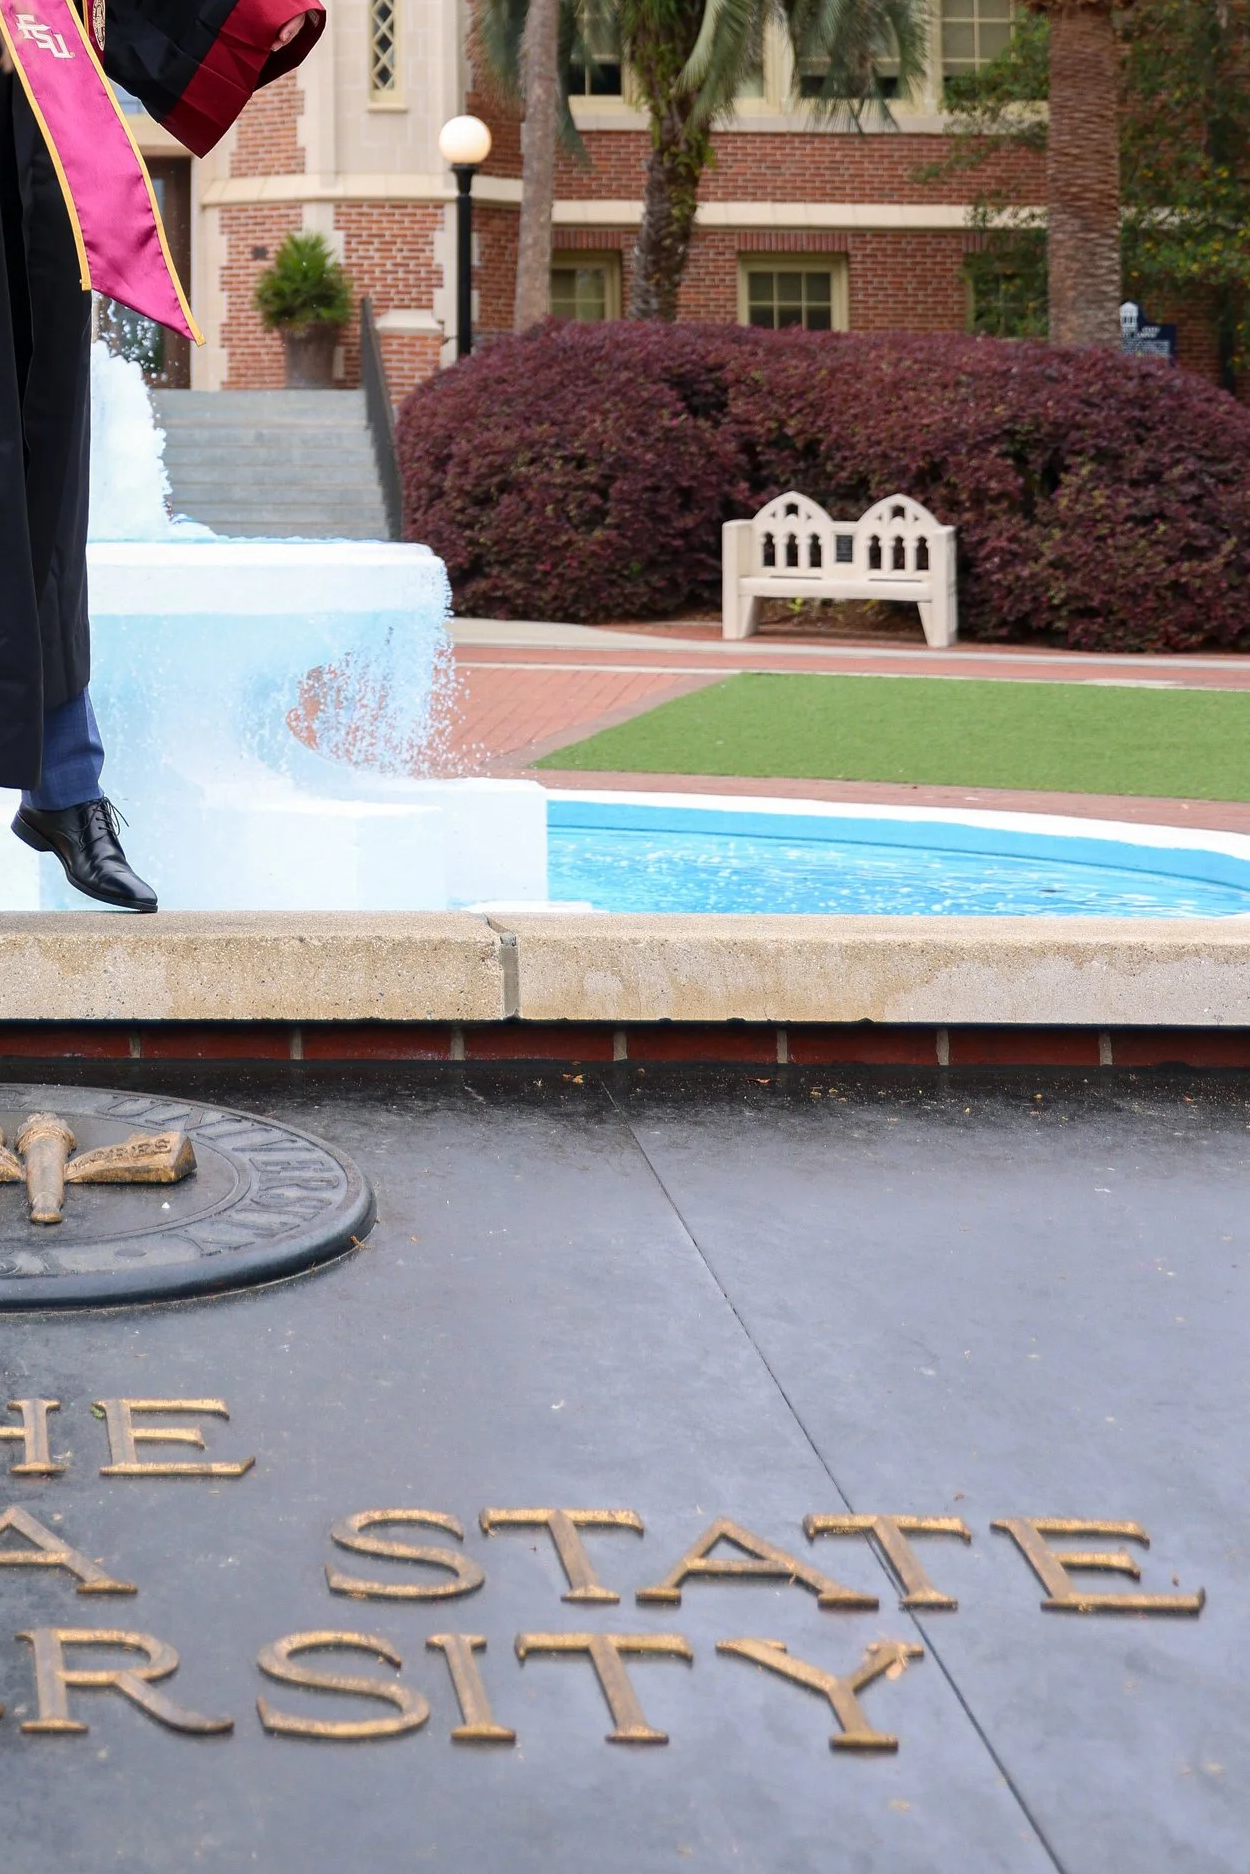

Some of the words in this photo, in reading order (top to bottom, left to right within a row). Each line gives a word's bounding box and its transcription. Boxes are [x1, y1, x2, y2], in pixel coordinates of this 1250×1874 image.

[15, 12, 75, 59] FSU
[98, 1095, 341, 1257] UNIVERSITY
[323, 1507, 1207, 1618] STATE
